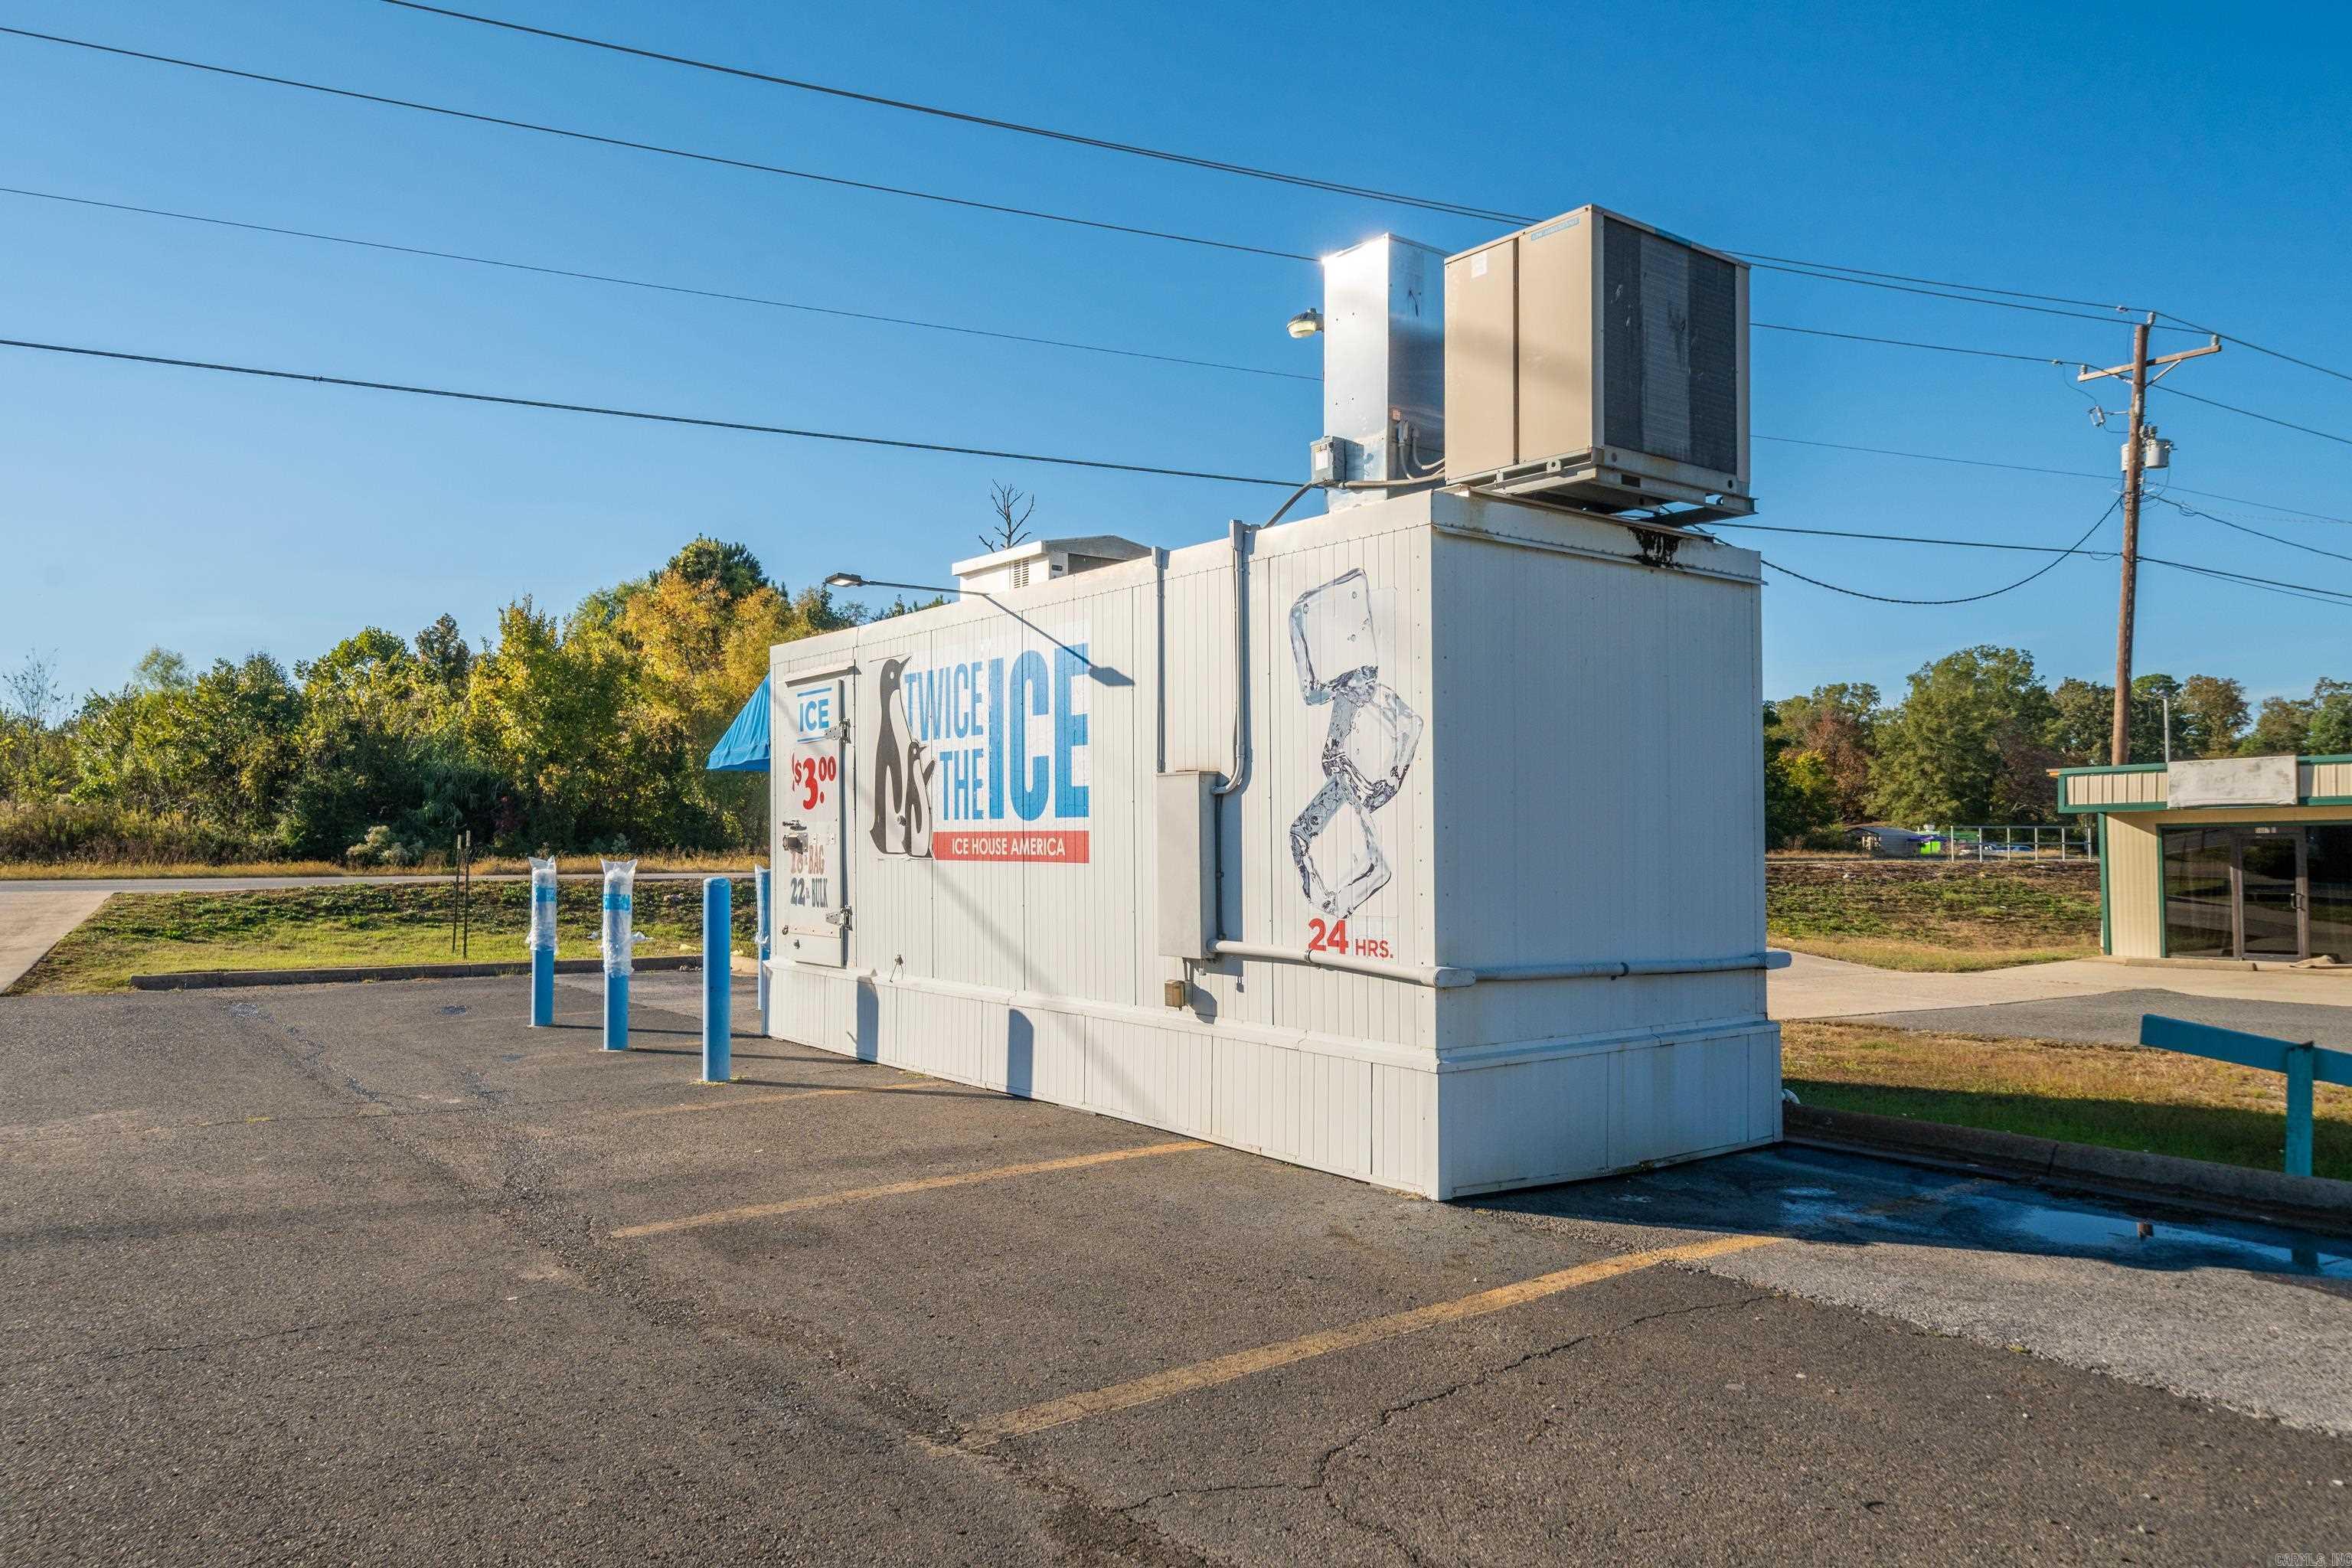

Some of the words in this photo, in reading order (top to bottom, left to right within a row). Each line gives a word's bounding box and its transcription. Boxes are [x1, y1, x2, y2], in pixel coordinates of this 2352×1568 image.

[799, 698, 829, 732] ICE
[904, 662, 983, 741] TWICE
[988, 643, 1089, 822] ICE
[939, 748, 984, 821] THE
[808, 844, 825, 874] BAG
[952, 838, 969, 854] ICE
[972, 838, 1008, 855] HOUSE
[1011, 837, 1066, 856] AMERICA
[790, 877, 805, 906] 22
[812, 877, 828, 908] BULK
[1308, 918, 1349, 955] 24
[1355, 939, 1393, 959] HRS.
